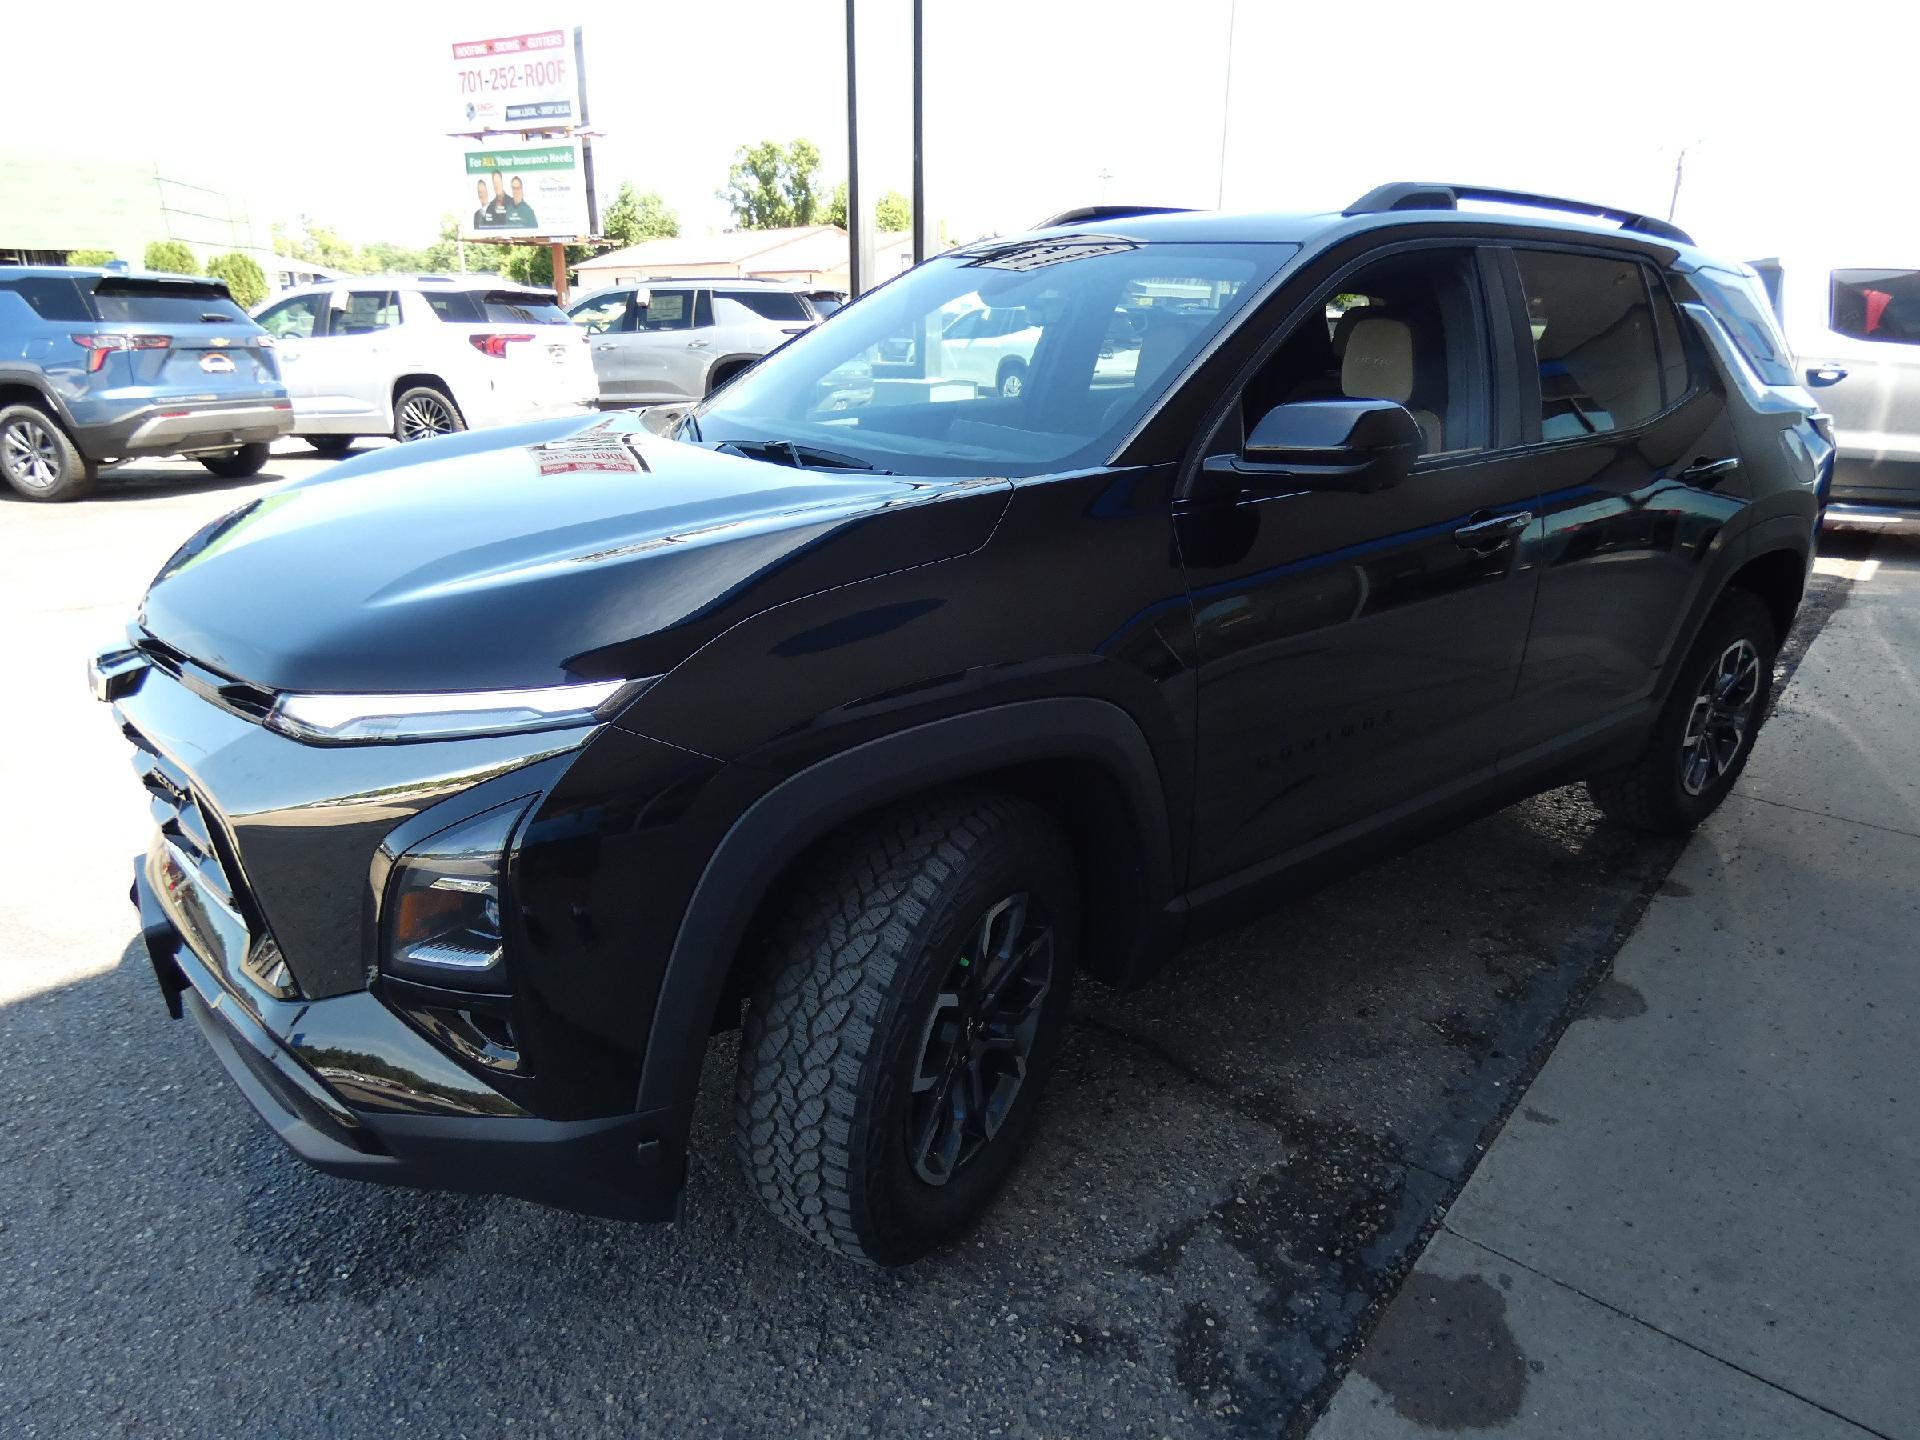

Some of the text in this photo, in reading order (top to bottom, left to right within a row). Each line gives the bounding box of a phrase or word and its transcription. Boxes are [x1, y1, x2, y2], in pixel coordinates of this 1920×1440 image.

[458, 60, 566, 94] 701-252-ROOF
[469, 152, 573, 167] For ALL Your Insurance Needs
